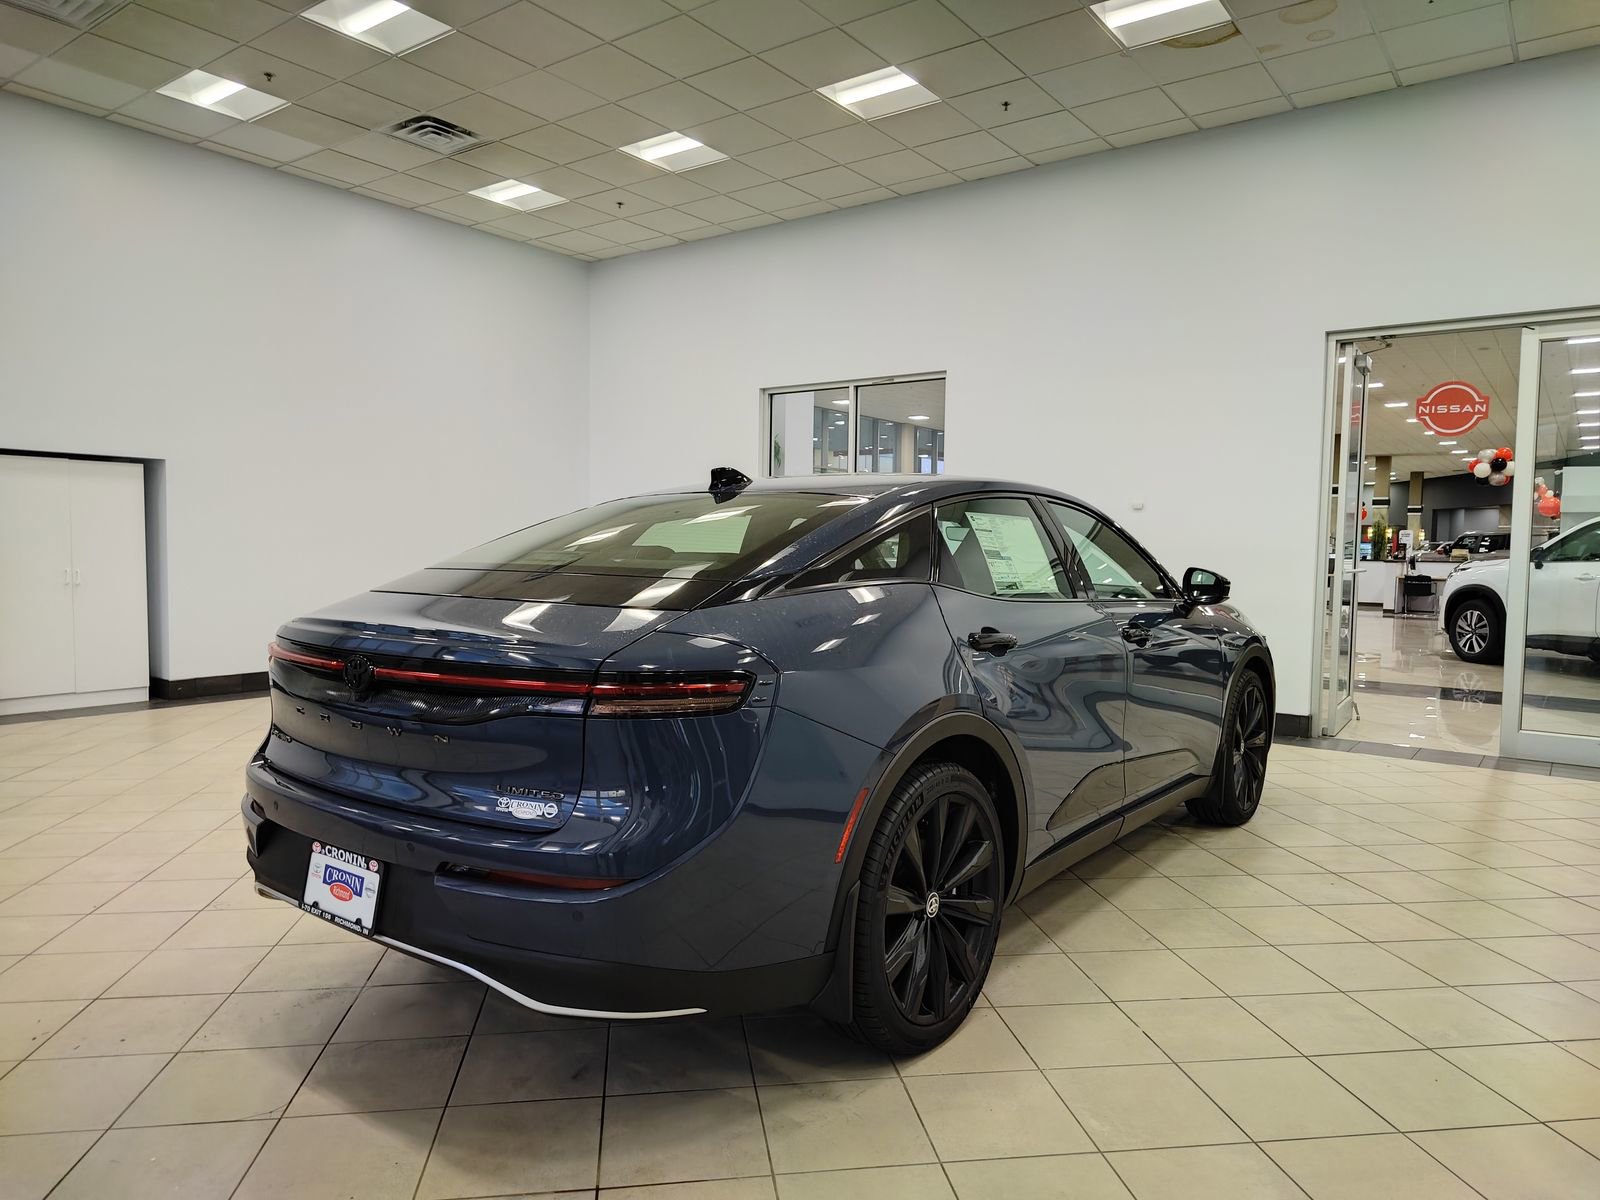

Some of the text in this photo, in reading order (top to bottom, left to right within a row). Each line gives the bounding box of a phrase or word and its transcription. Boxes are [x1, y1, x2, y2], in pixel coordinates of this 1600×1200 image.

[1418, 404, 1487, 414] NISSAN
[496, 785, 566, 800] LIMITED
[511, 801, 544, 811] CRONIN
[325, 845, 365, 868] CRONIN
[326, 868, 361, 894] CRONIN
[311, 907, 322, 916] EXIT
